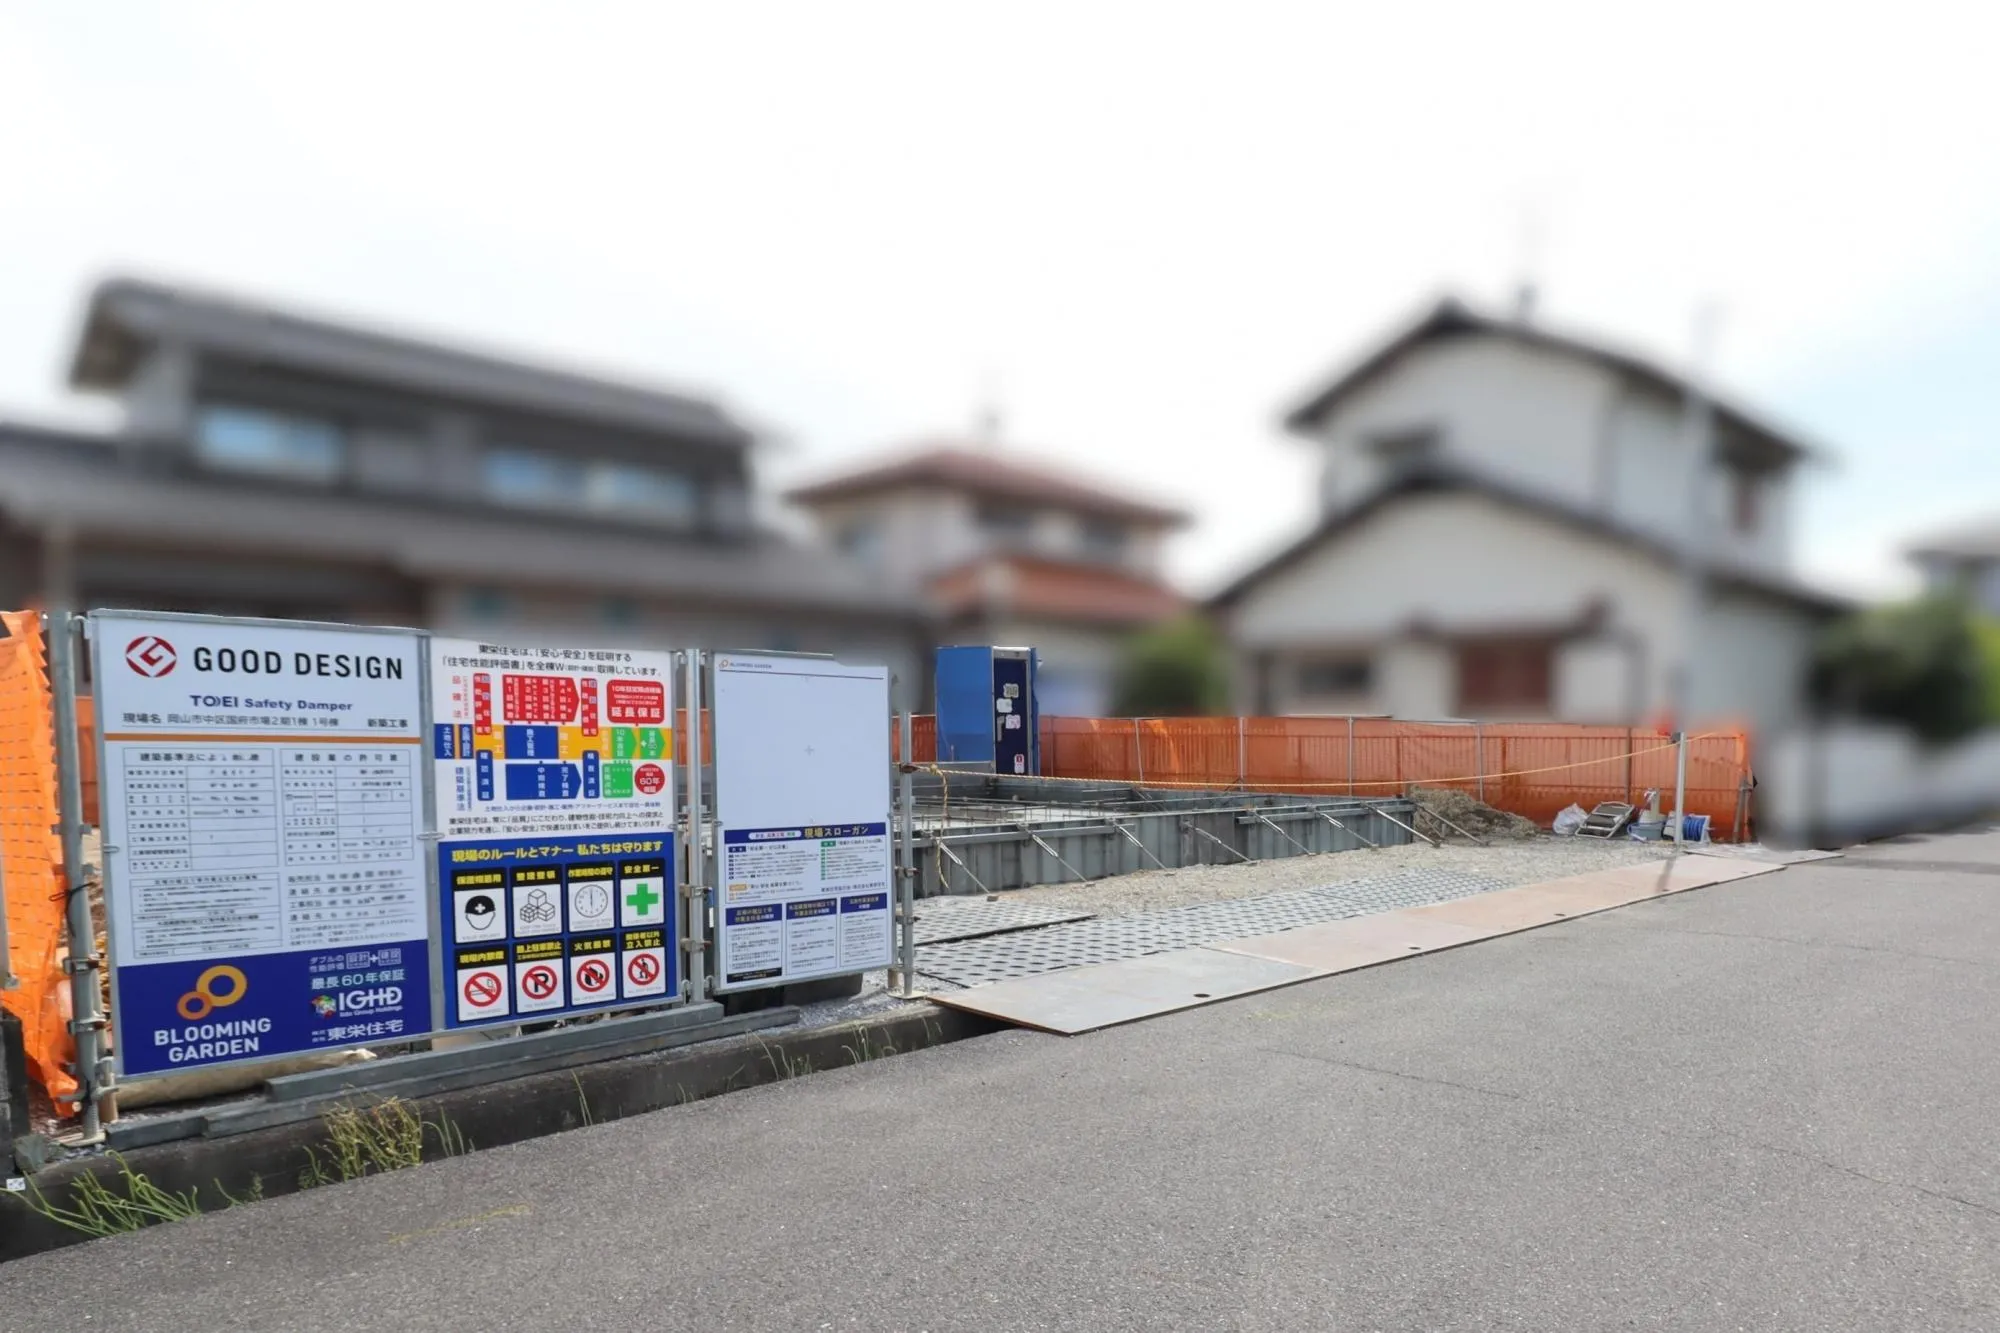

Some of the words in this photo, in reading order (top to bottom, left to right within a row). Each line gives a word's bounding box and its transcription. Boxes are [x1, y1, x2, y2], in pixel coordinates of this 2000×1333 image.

[193, 647, 282, 674] GOOD
[294, 652, 403, 679] DESIGN
[244, 698, 292, 711] Safety
[297, 700, 353, 711] Damper
[122, 712, 161, 724] 現場名
[367, 718, 409, 729] 新築工事
[804, 826, 869, 839] 現場スローガン
[452, 846, 574, 863] 現場のルールとマナー
[577, 841, 663, 856] 私たちは守ります
[624, 865, 660, 874] 安全第一
[574, 940, 611, 951] 火気厳禁
[626, 939, 661, 949] 立入禁止
[338, 986, 402, 1011] IGHD
[154, 1017, 271, 1046] BLOOMING
[327, 1019, 404, 1041] 東栄住宅
[168, 1037, 259, 1063] GARDEN
